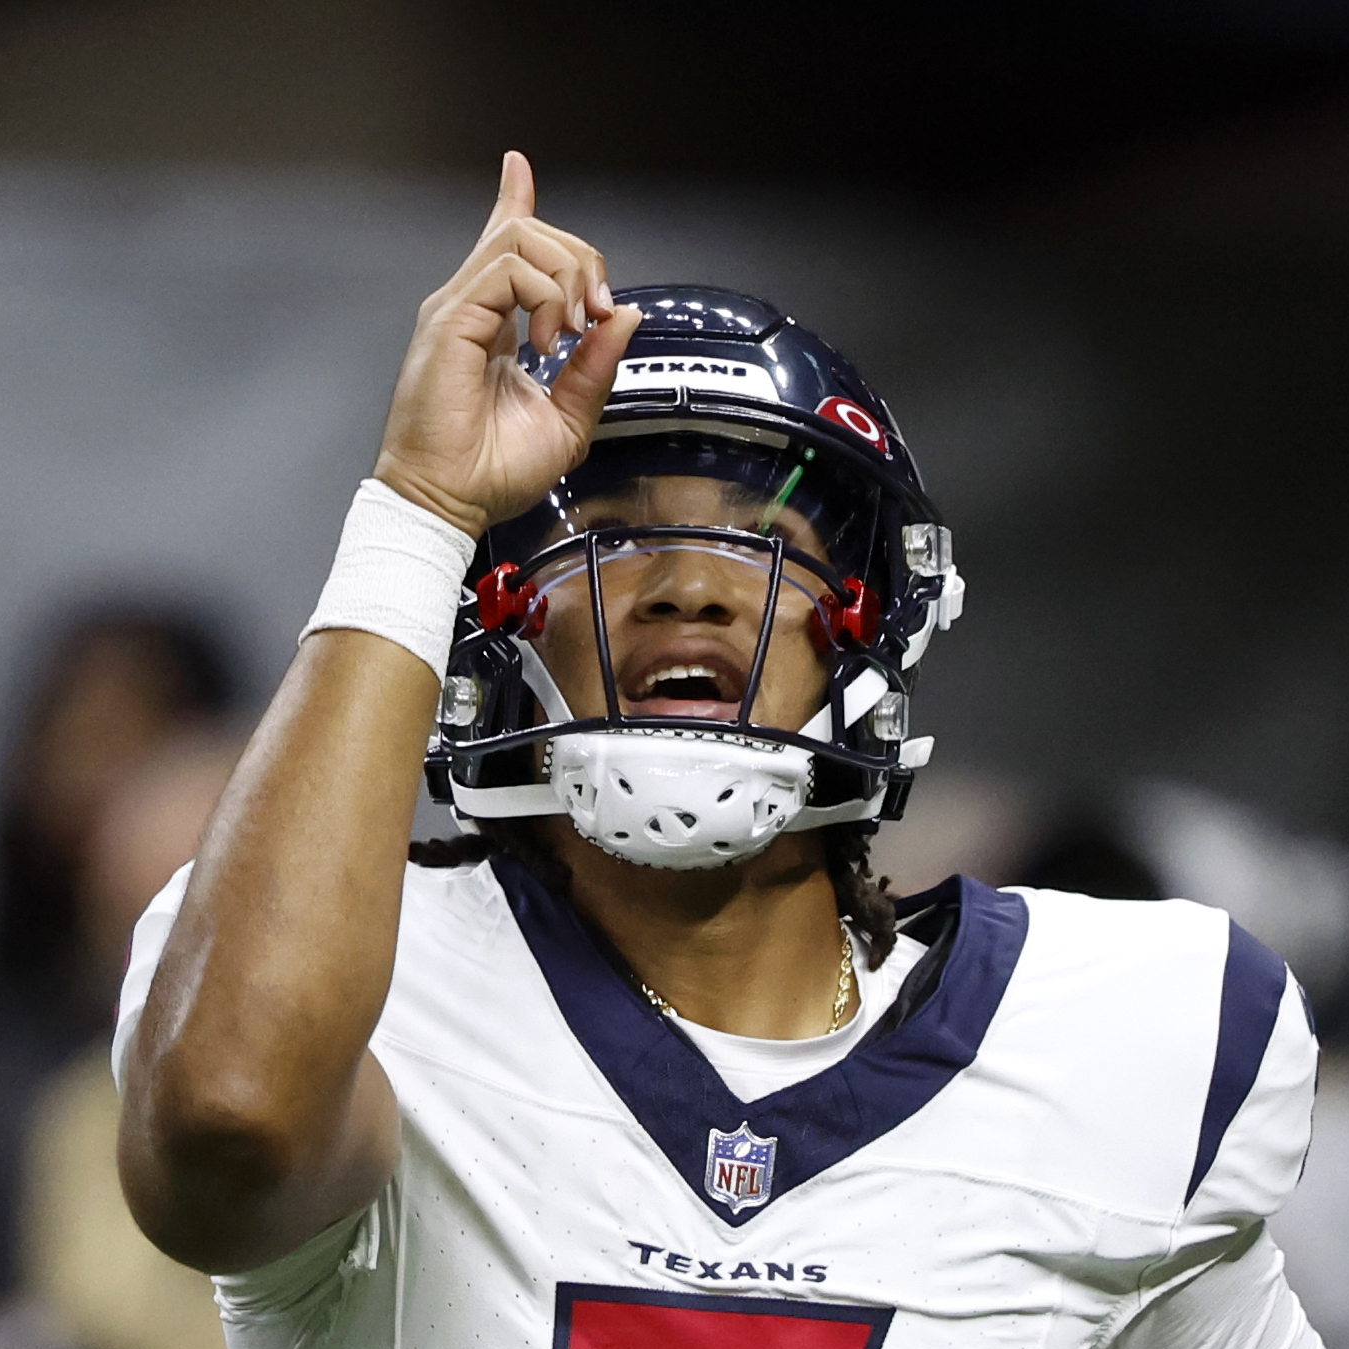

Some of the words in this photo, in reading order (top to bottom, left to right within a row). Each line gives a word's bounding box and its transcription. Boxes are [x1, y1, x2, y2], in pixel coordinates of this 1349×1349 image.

[625, 361, 748, 377] TEXANS
[717, 1161, 762, 1196] NFL
[627, 1240, 828, 1282] TEXANS
